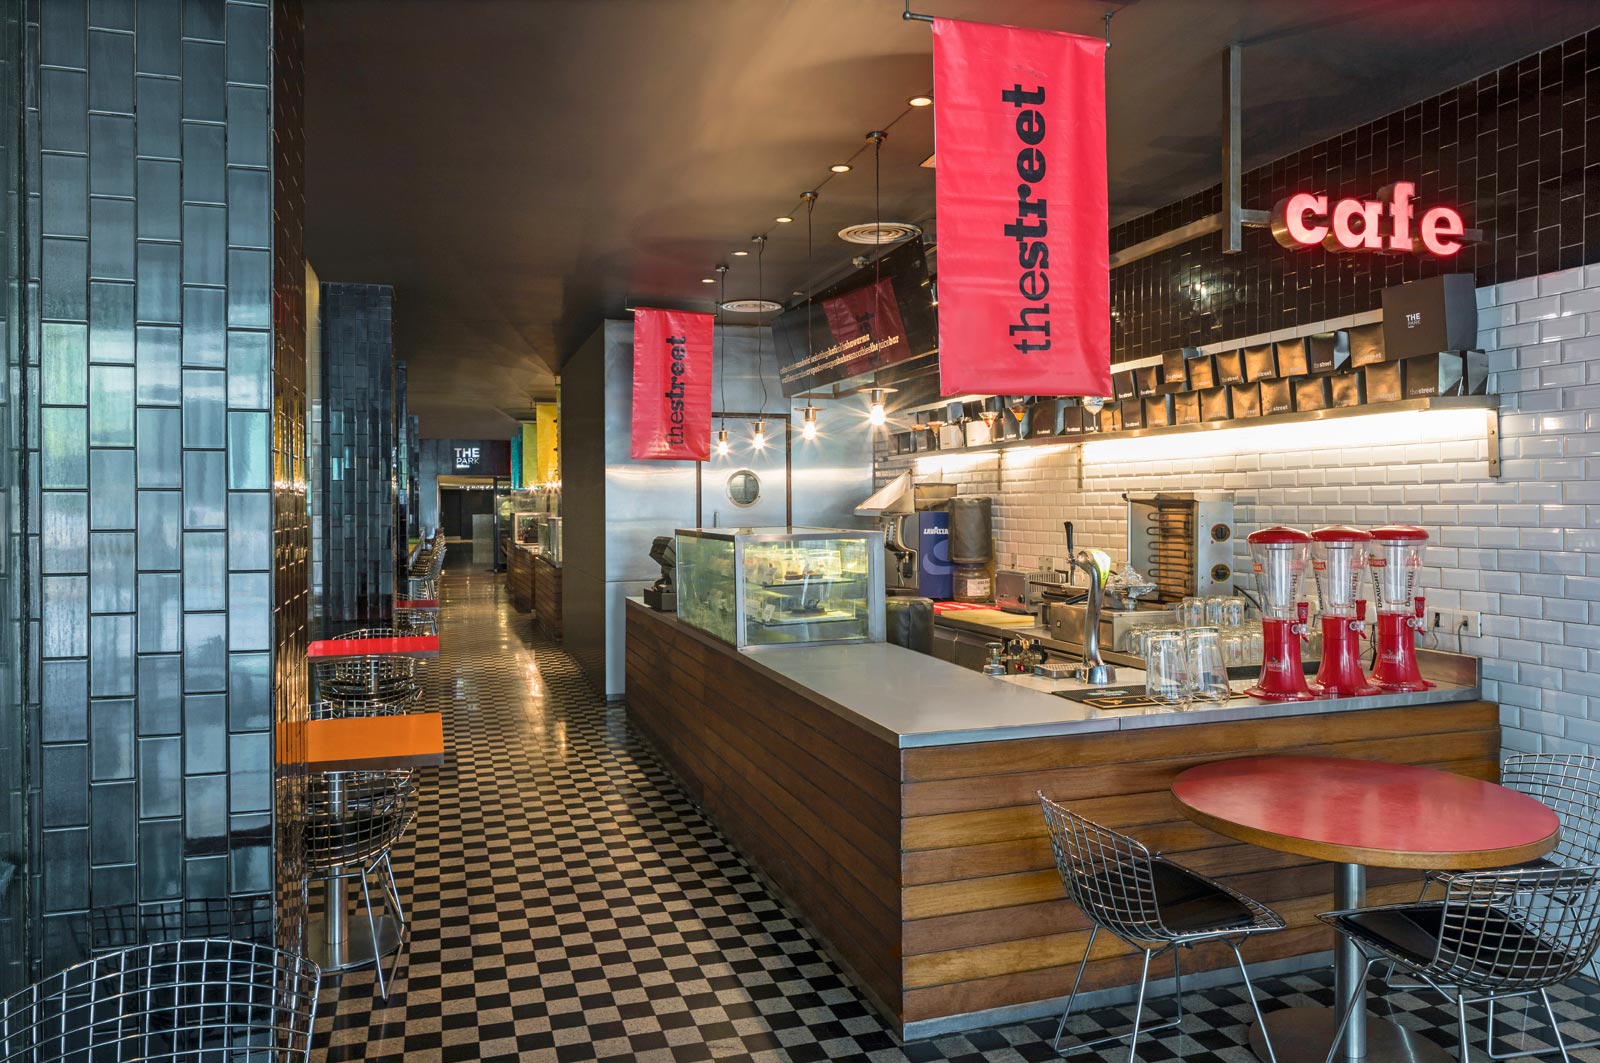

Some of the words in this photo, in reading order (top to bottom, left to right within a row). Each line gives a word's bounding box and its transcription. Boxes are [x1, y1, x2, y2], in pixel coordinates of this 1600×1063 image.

[1002, 84, 1051, 354] thestreet
[1285, 182, 1465, 256] cafe
[1406, 313, 1421, 322] THE
[665, 335, 687, 445] thestreet
[454, 448, 480, 458] THE
